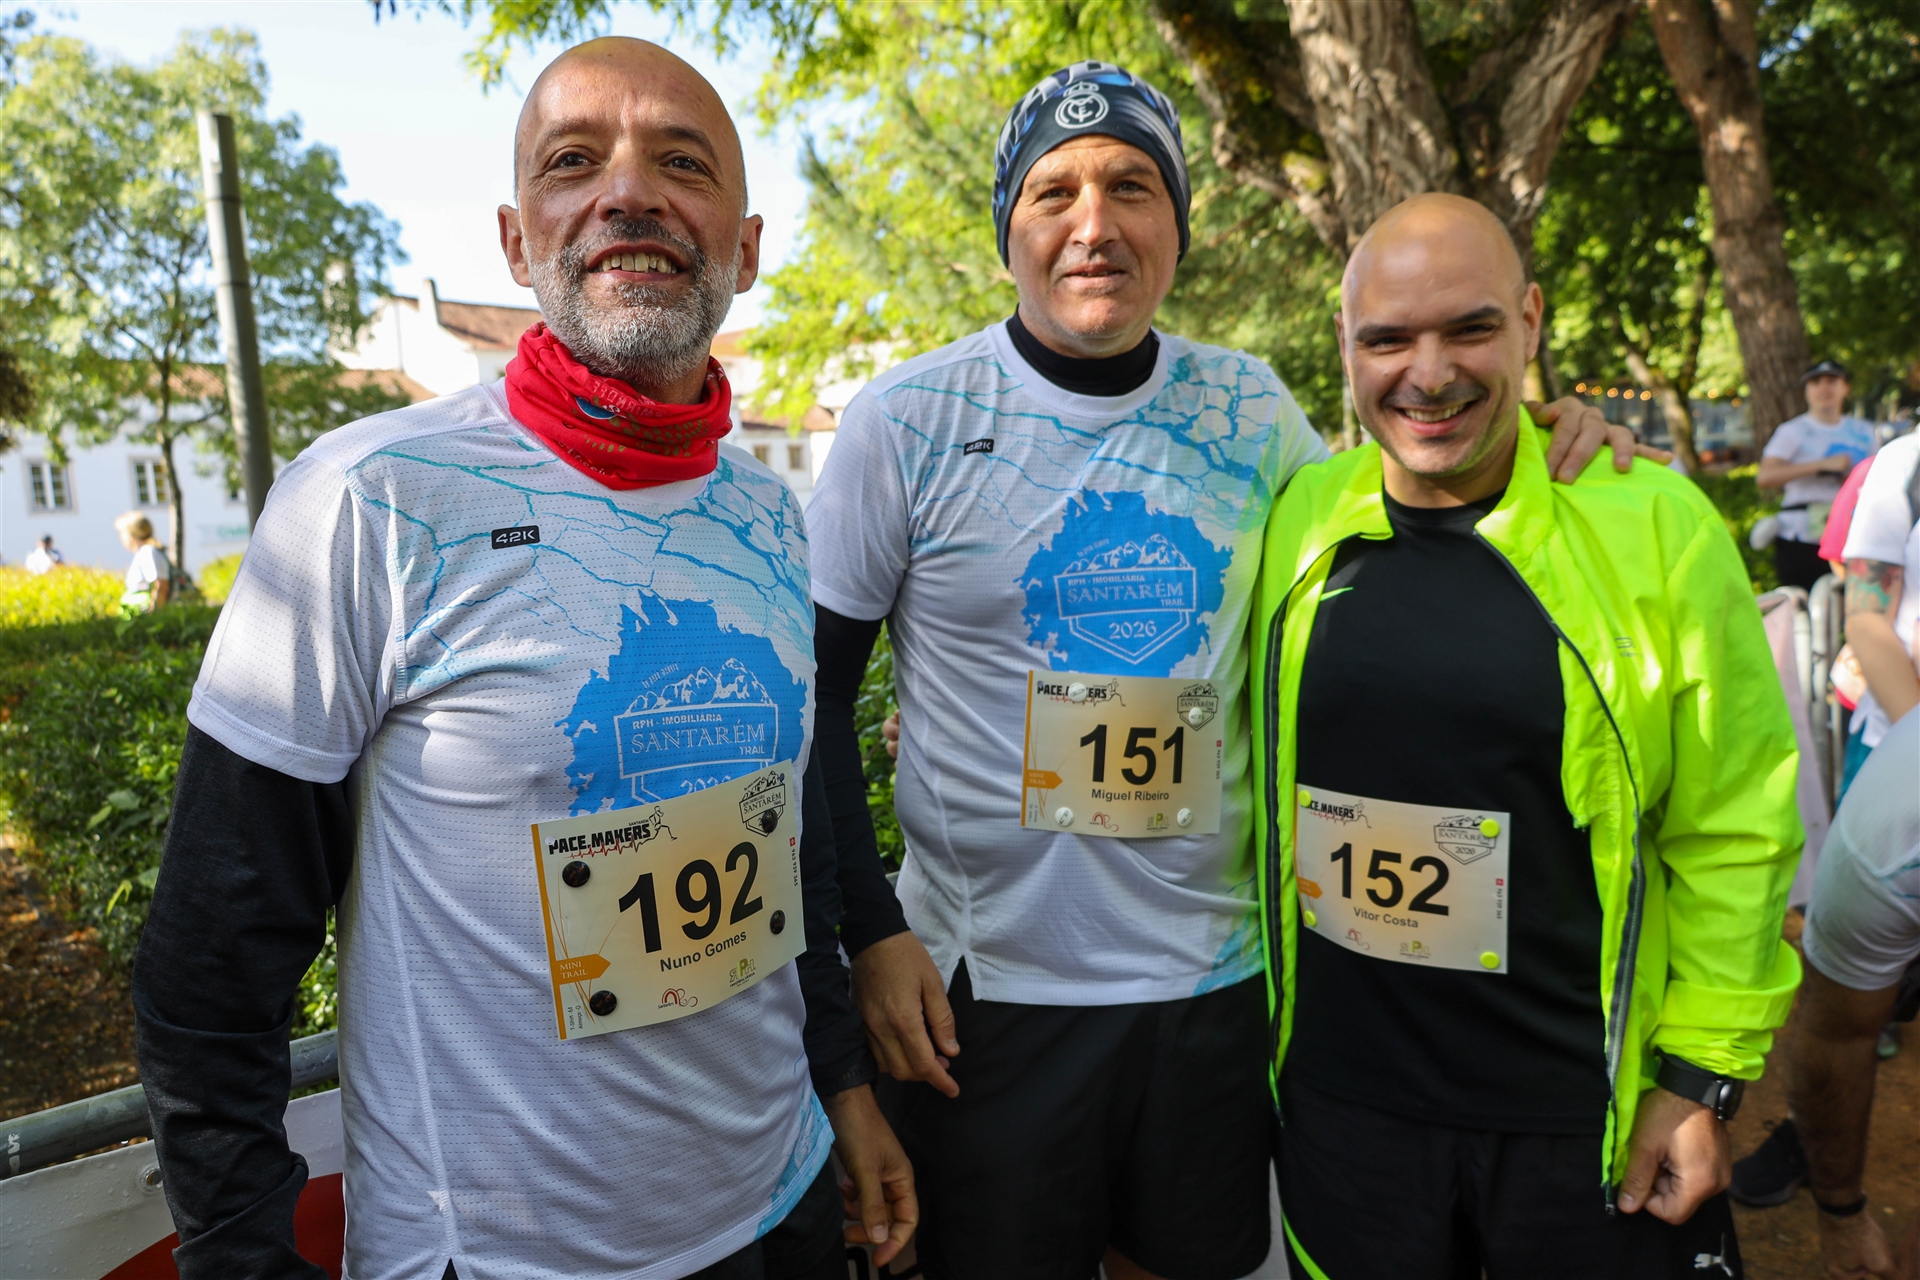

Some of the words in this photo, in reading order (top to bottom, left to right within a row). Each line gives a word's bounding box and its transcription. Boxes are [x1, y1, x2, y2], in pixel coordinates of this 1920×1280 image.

[966, 441, 991, 452] 42K
[496, 530, 535, 543] 42K
[1068, 577, 1086, 586] RPH
[1067, 579, 1184, 604] SANTARÉM
[1160, 598, 1185, 607] TRAIL
[1108, 620, 1157, 639] 2026
[633, 719, 655, 729] RPH
[631, 719, 766, 754] SANTARÉM
[739, 745, 766, 756] TRAIL
[1079, 723, 1185, 786] 151
[1091, 788, 1131, 802] Miguel
[1135, 788, 1170, 801] Ribeiro
[743, 792, 782, 814] SANTARÉM
[1455, 846, 1476, 855] 2026
[1330, 842, 1449, 916] 152
[618, 841, 763, 954] 192
[1354, 907, 1379, 922] Vitor
[1383, 913, 1419, 928] Costa
[660, 952, 701, 972] Nuno
[704, 931, 747, 958] Gomes
[559, 961, 582, 971] MINI
[560, 968, 588, 979] TRAIL
